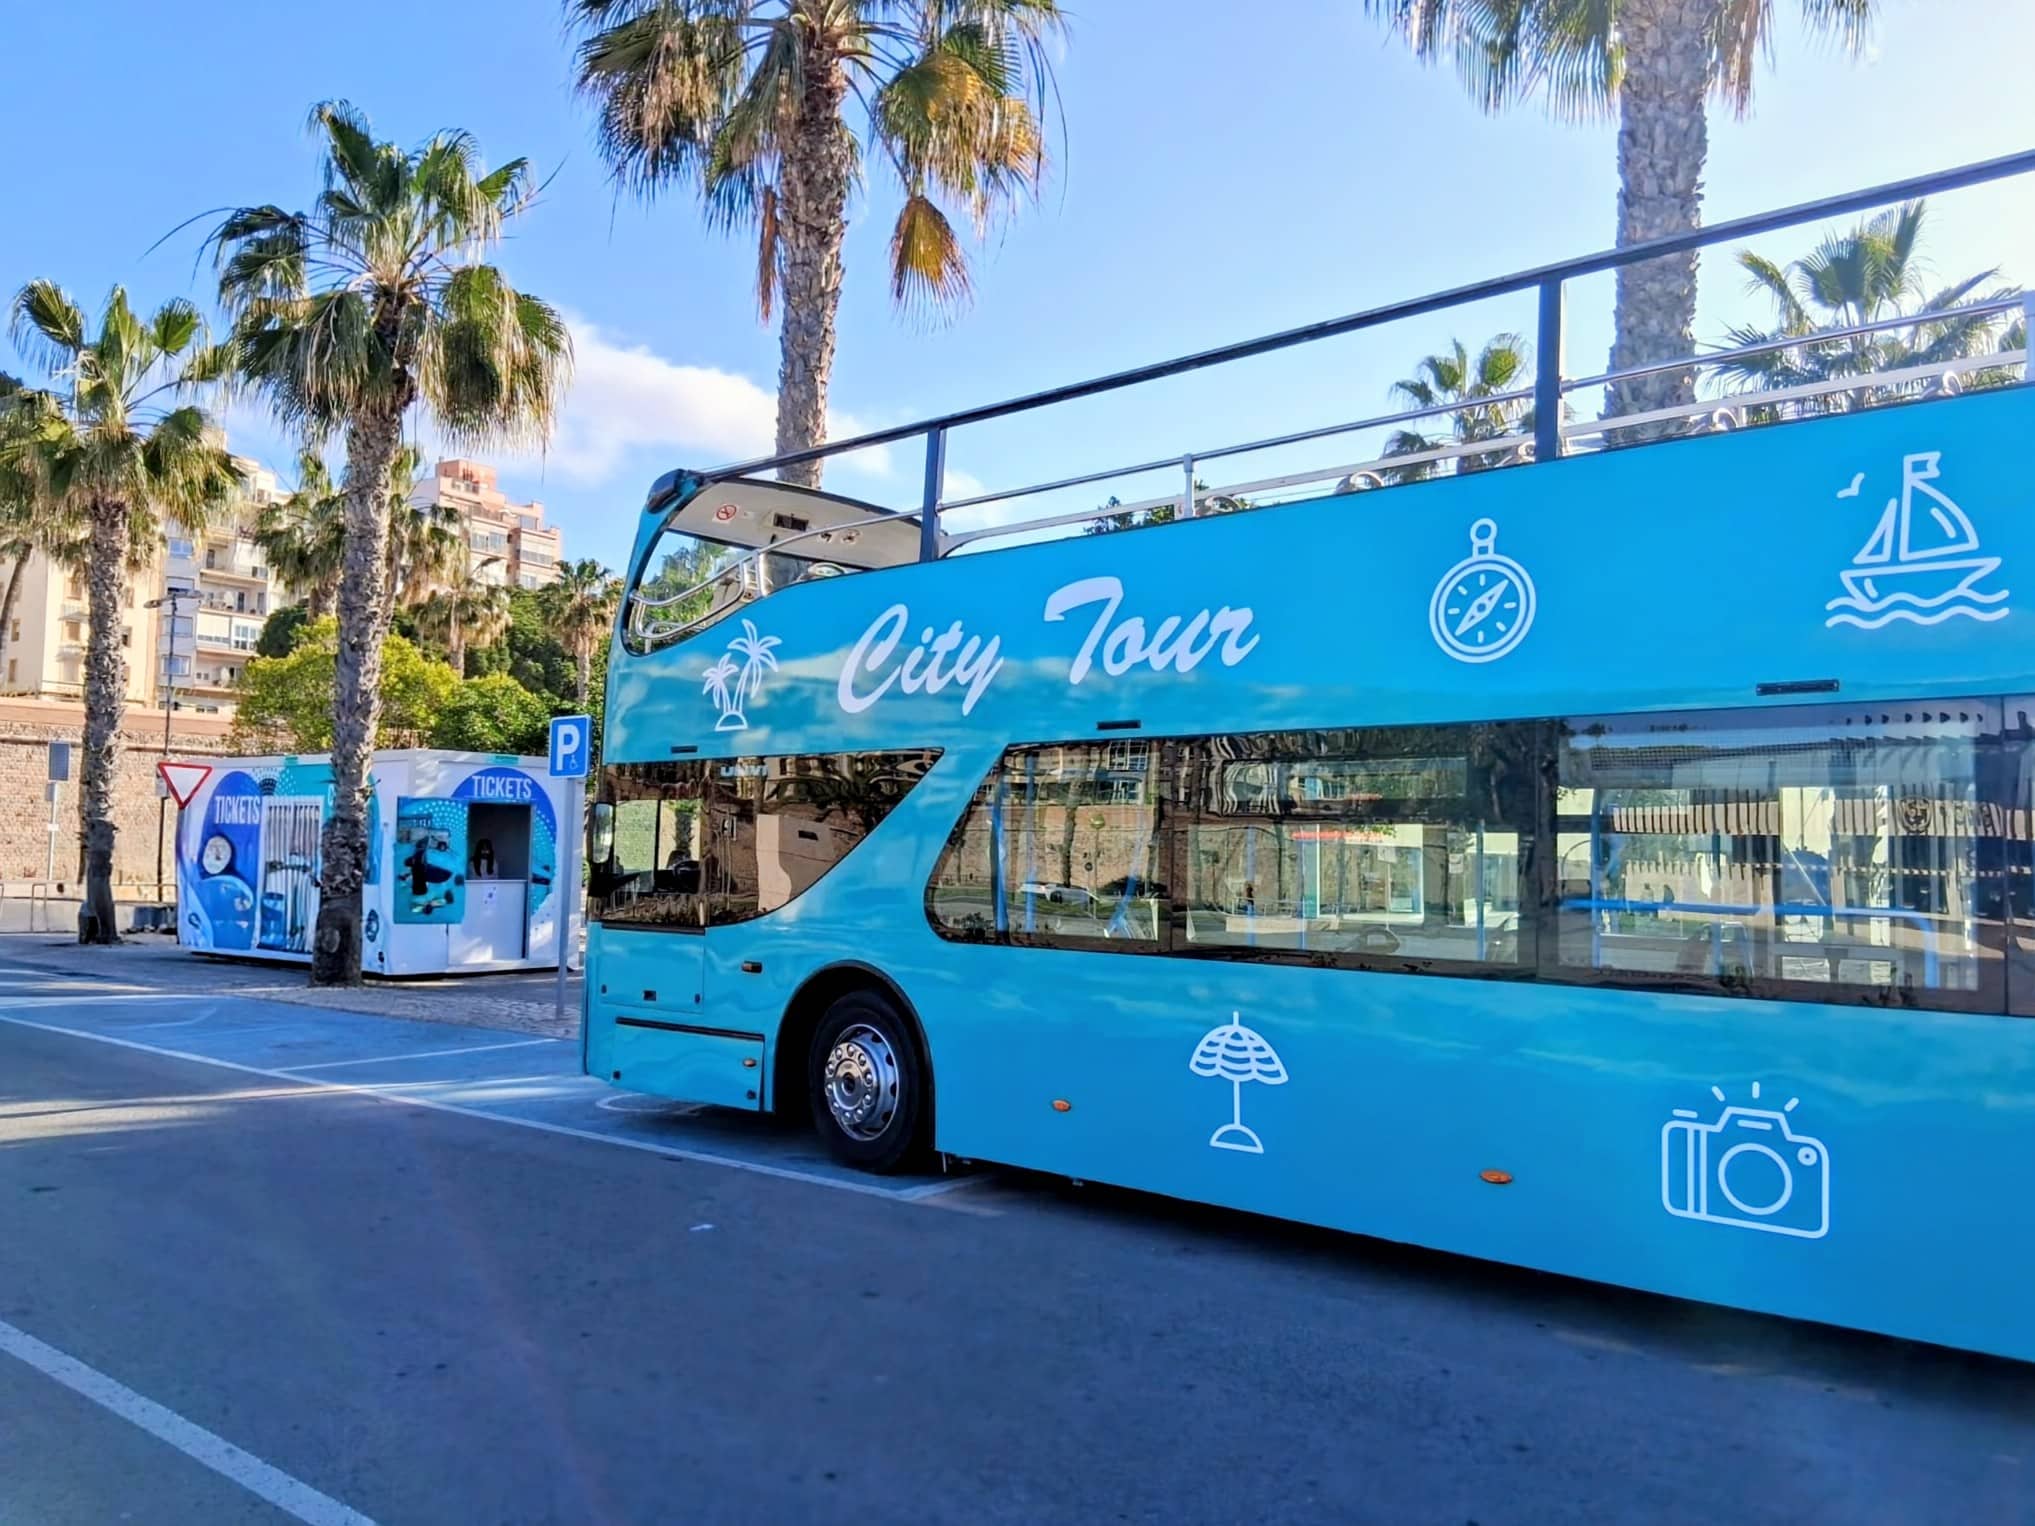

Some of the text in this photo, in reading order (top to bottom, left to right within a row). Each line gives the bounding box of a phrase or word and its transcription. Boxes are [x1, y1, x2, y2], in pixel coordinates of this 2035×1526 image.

[837, 576, 1260, 716] City Tour
[556, 724, 580, 771] P
[471, 775, 532, 799] TICKETS
[215, 795, 261, 825] TICKETS
